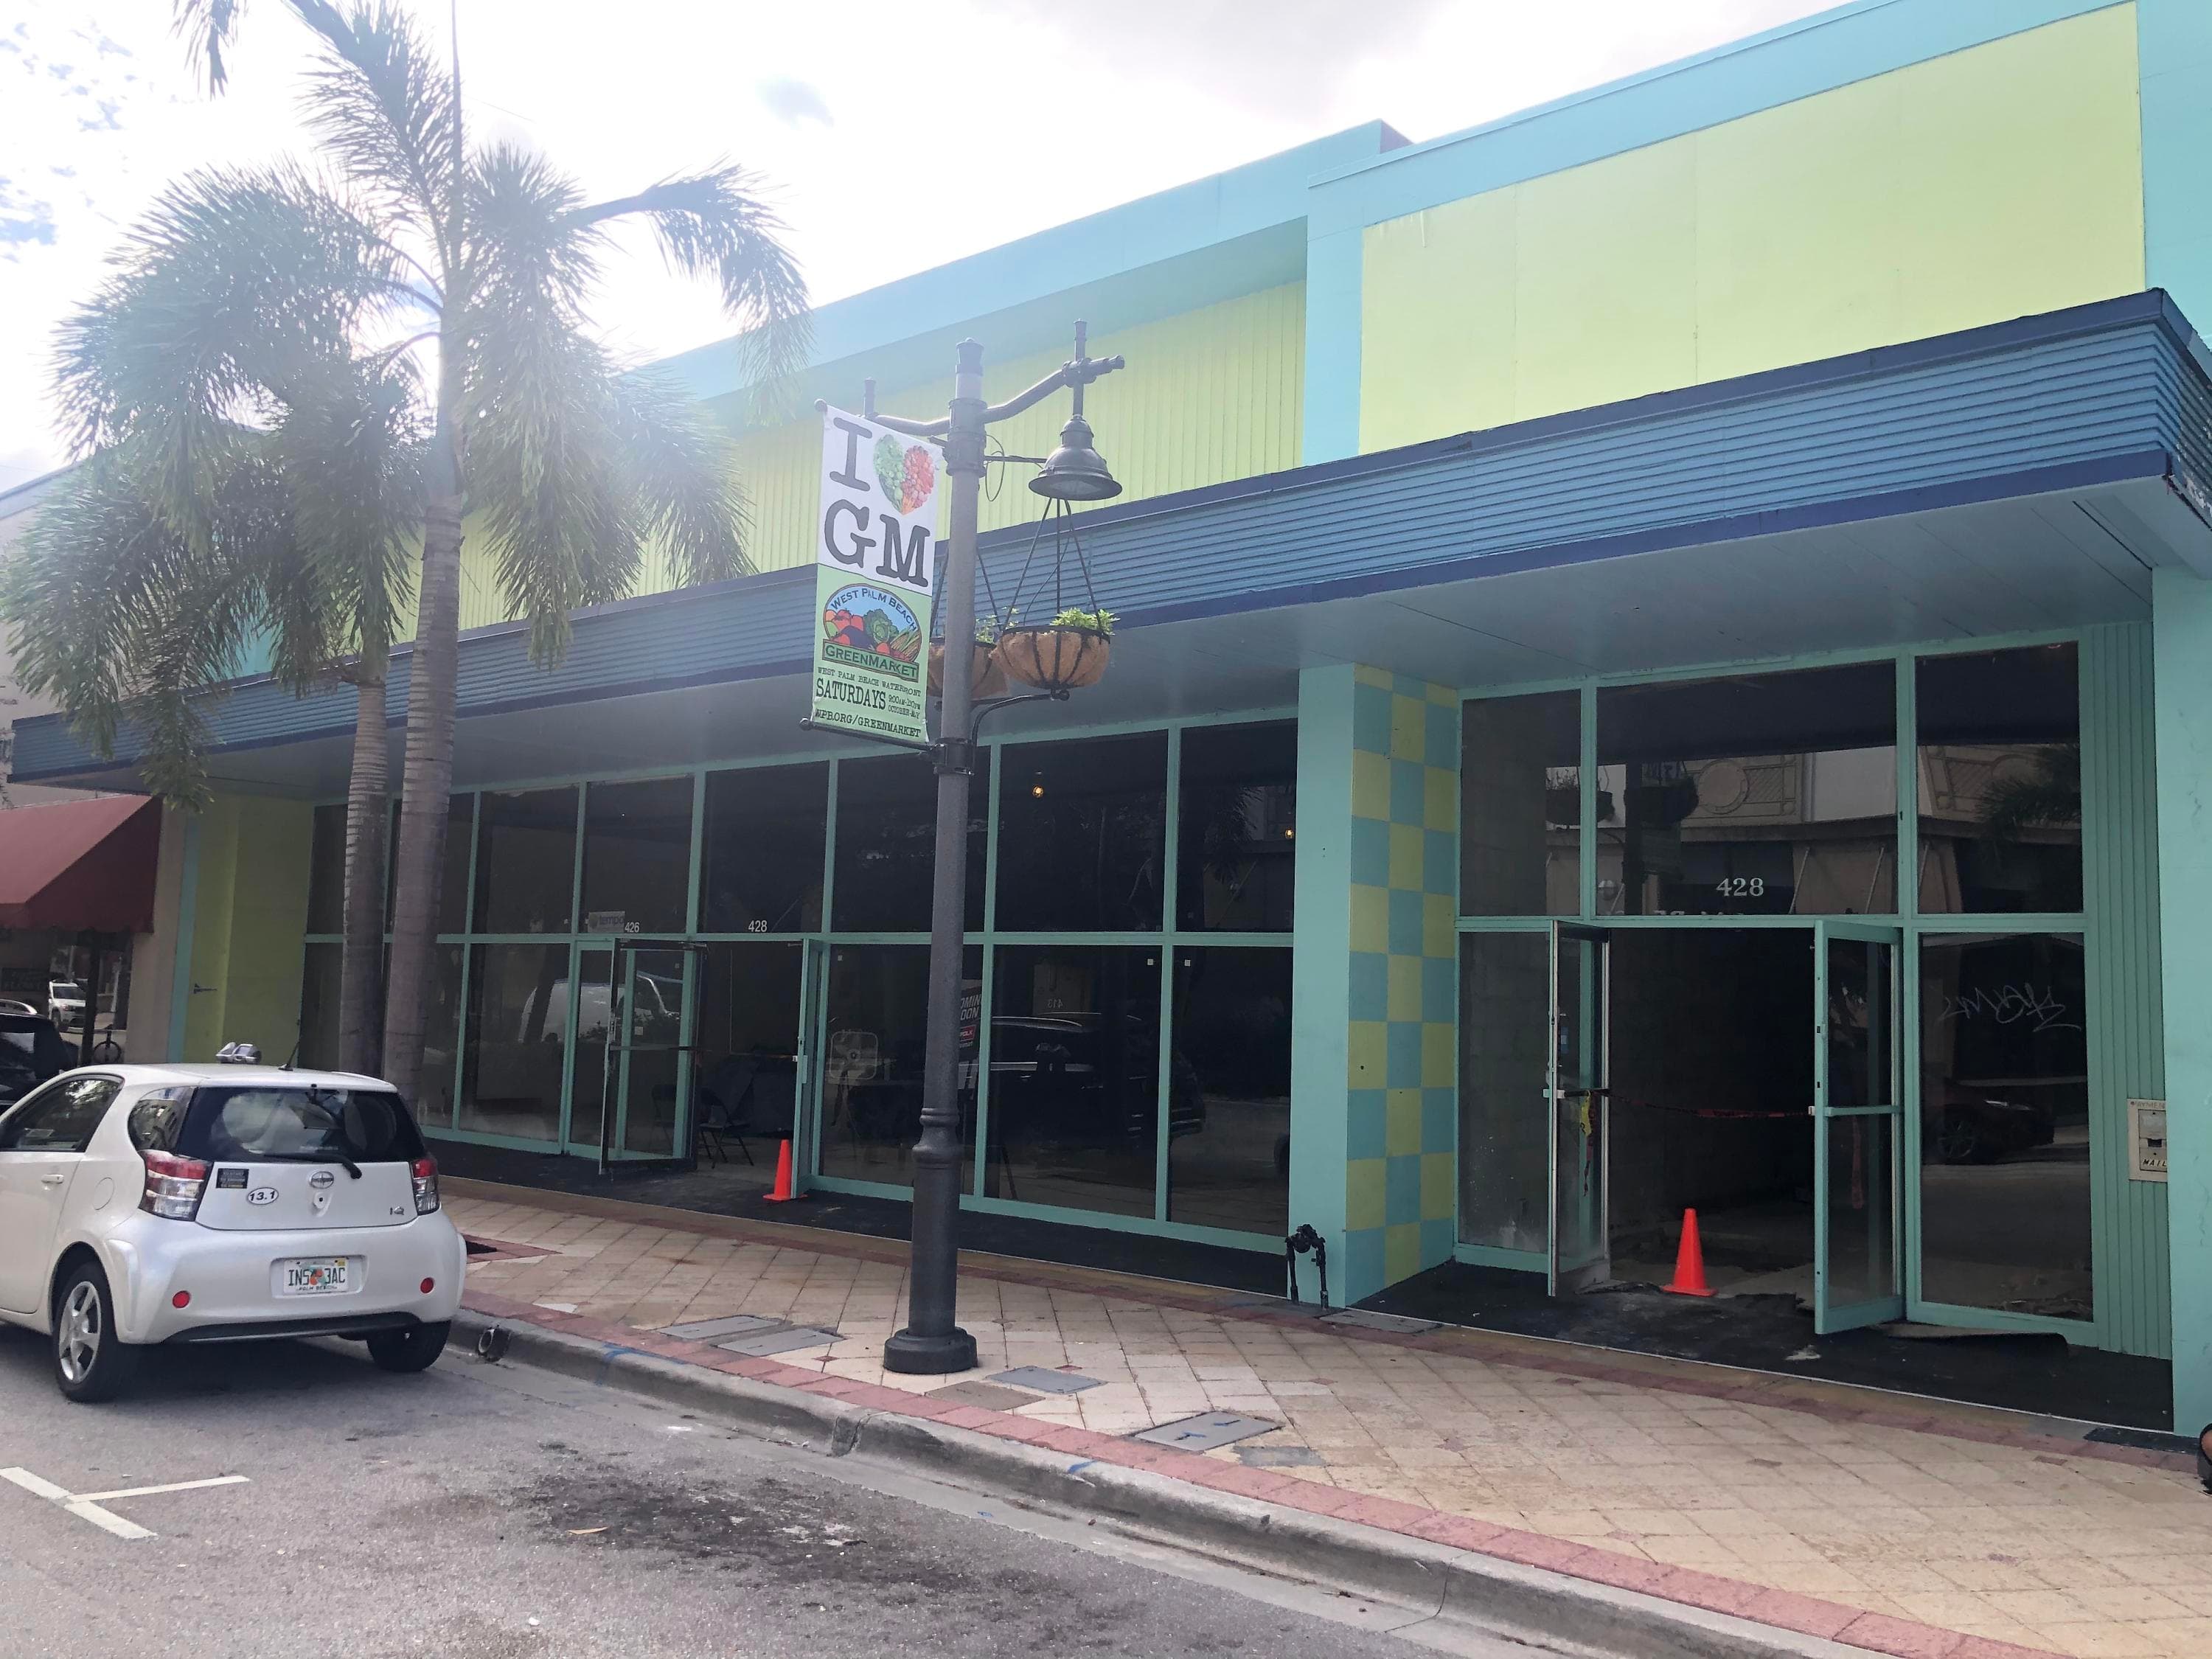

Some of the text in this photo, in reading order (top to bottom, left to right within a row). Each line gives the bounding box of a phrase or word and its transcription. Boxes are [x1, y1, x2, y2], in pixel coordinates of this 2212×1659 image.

[830, 417, 873, 492] I
[824, 499, 931, 587] GM
[830, 588, 918, 632] WEST PALM BEACH
[825, 644, 917, 678] GREENMARKET
[816, 678, 886, 710] SATURDAYS
[818, 667, 922, 698] WEST PALM BEACH WATERFRONT
[815, 709, 921, 737] WPB.ORG/GREENMARKET
[1716, 877, 1764, 897] 428
[625, 922, 640, 933] 426
[748, 919, 768, 933] 428
[2143, 1158, 2167, 1167] MAIL
[249, 1190, 276, 1201] 13.1
